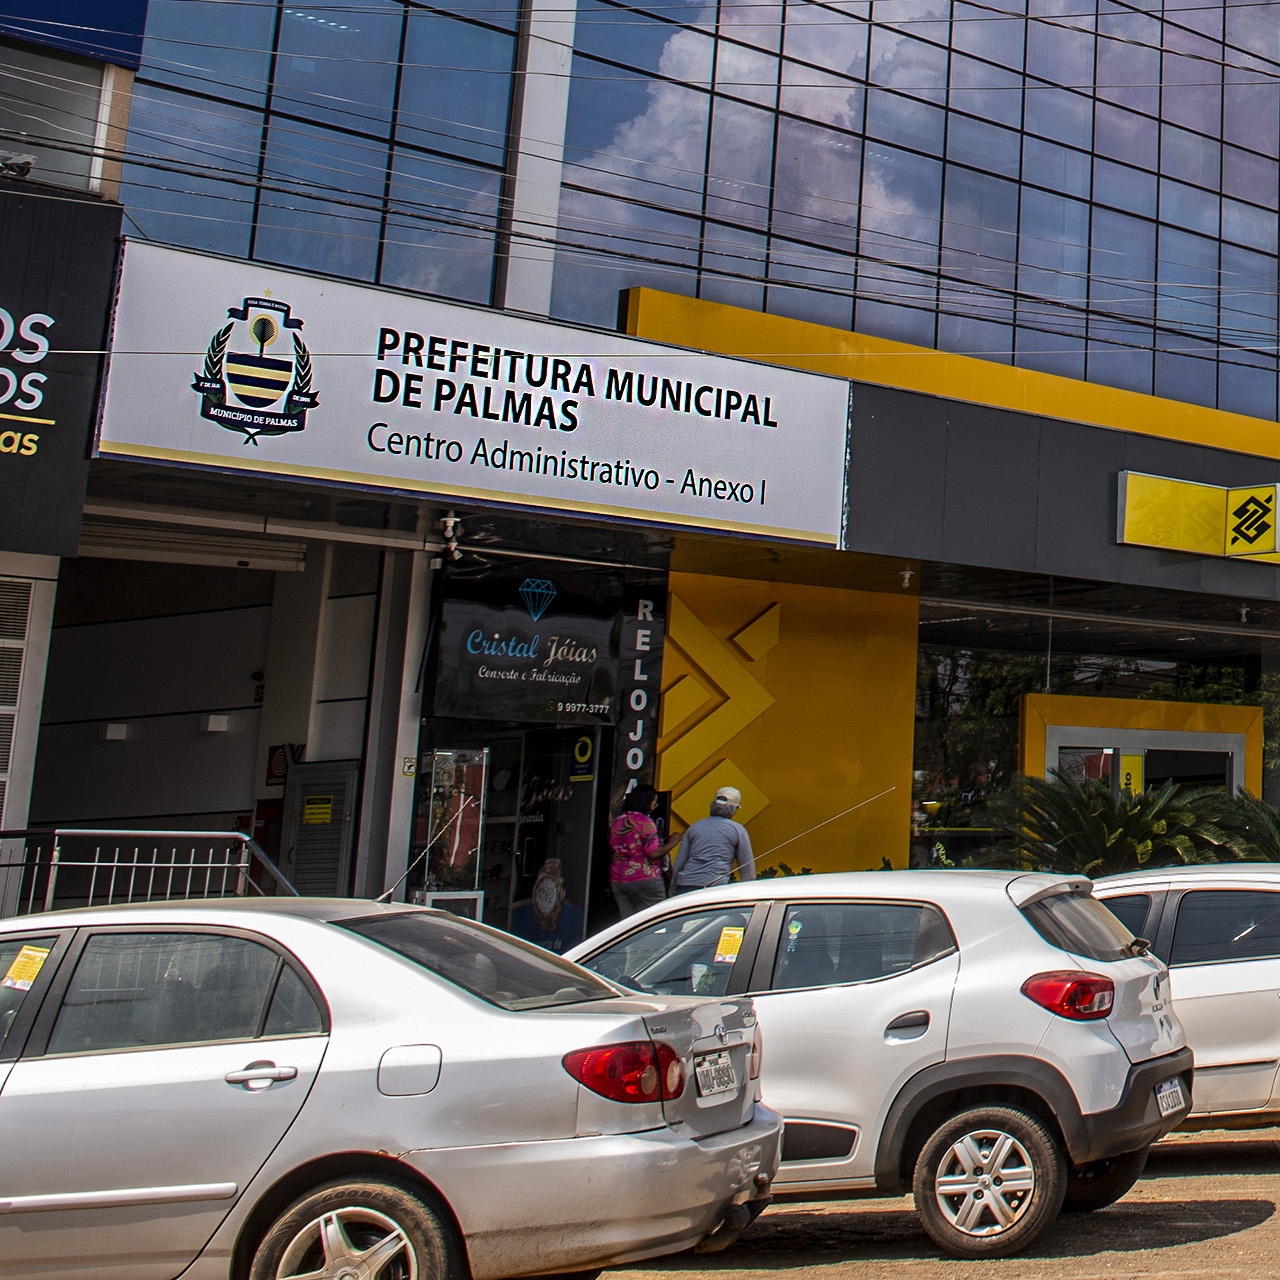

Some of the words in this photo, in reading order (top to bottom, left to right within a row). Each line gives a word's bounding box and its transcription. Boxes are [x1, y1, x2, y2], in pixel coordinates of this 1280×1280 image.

[376, 327, 596, 397] PREFEITURA
[605, 368, 778, 428] MUNICIPAL
[209, 407, 252, 422] MUNICÍPIO
[253, 415, 265, 424] DE
[265, 417, 298, 427] PALMAS
[372, 368, 424, 409] DE
[433, 378, 579, 432] PALMAS
[367, 422, 463, 463] Centro
[469, 438, 660, 491] Administrativo
[679, 468, 754, 504] Anexo
[466, 629, 540, 659] Cristal
[543, 635, 597, 668] Jóias
[478, 664, 519, 681] Conserto
[556, 702, 564, 712] 9
[565, 702, 610, 714] 9977-3777
